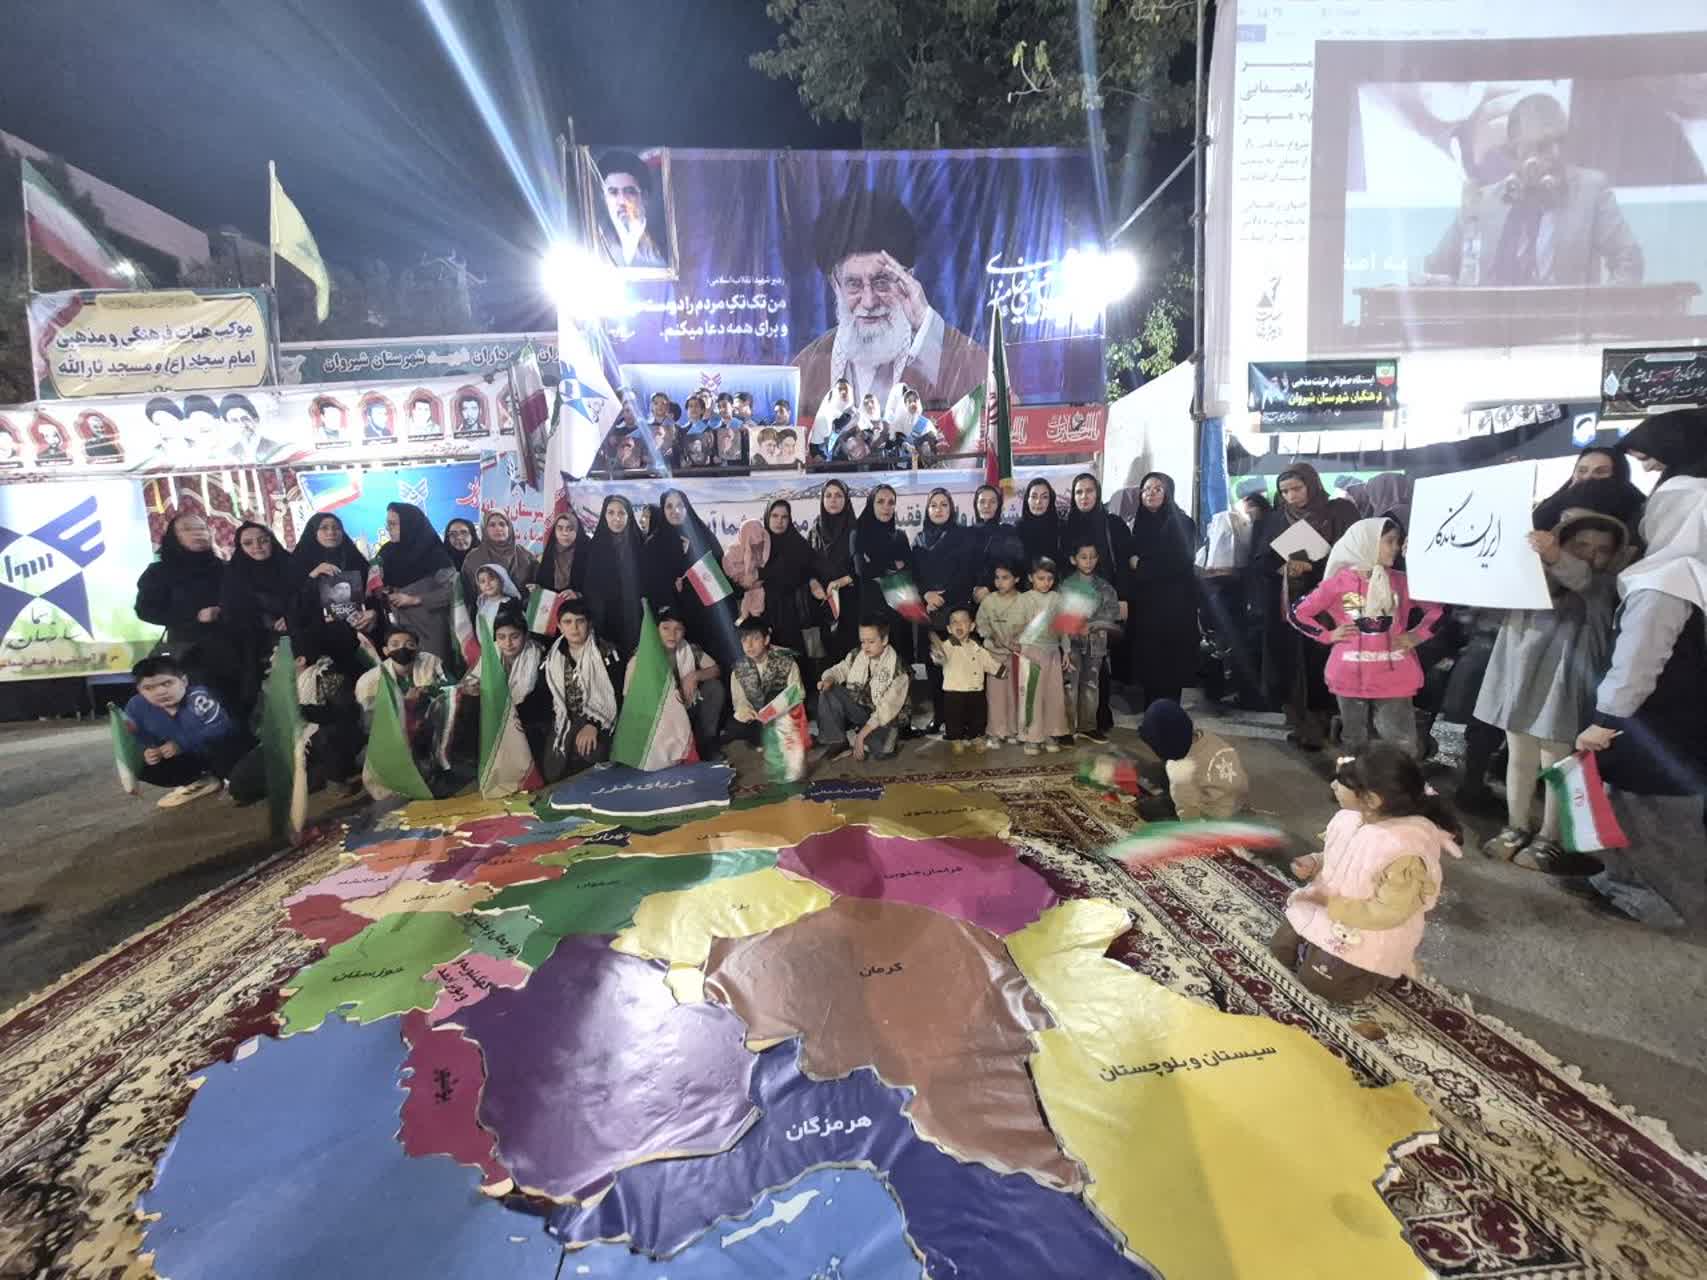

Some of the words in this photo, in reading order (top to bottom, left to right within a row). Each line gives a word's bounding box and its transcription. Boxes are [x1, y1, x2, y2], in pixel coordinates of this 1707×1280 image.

[685, 296, 694, 314] را
[695, 298, 726, 315] مردم
[746, 294, 767, 309] تک
[767, 298, 787, 313] من
[214, 320, 253, 342] موکب
[705, 320, 726, 335] دعا
[727, 323, 753, 334] همه
[755, 320, 779, 338] برای
[781, 325, 788, 337] و
[56, 325, 110, 348] مذهبی
[110, 333, 118, 347] و
[108, 360, 151, 375] مسجد
[189, 353, 225, 368] سجاد
[228, 350, 256, 373] امام
[323, 352, 369, 373] شیروان
[371, 348, 425, 371] شهرستان
[153, 362, 162, 375] و
[1288, 391, 1316, 406] شیروان
[1317, 391, 1350, 405] شهرستان
[1351, 389, 1382, 404] فرهنگیان
[1424, 489, 1473, 553] ماندگار
[1451, 511, 1502, 569] ایران
[923, 865, 963, 877] خراسان
[331, 966, 404, 983] خوزستان
[859, 961, 903, 978] کرمان
[1190, 1057, 1202, 1070] و
[1202, 1043, 1277, 1068] سیستان
[1099, 1057, 1188, 1082] بلوچستان
[785, 1114, 873, 1142] هرمزگان
